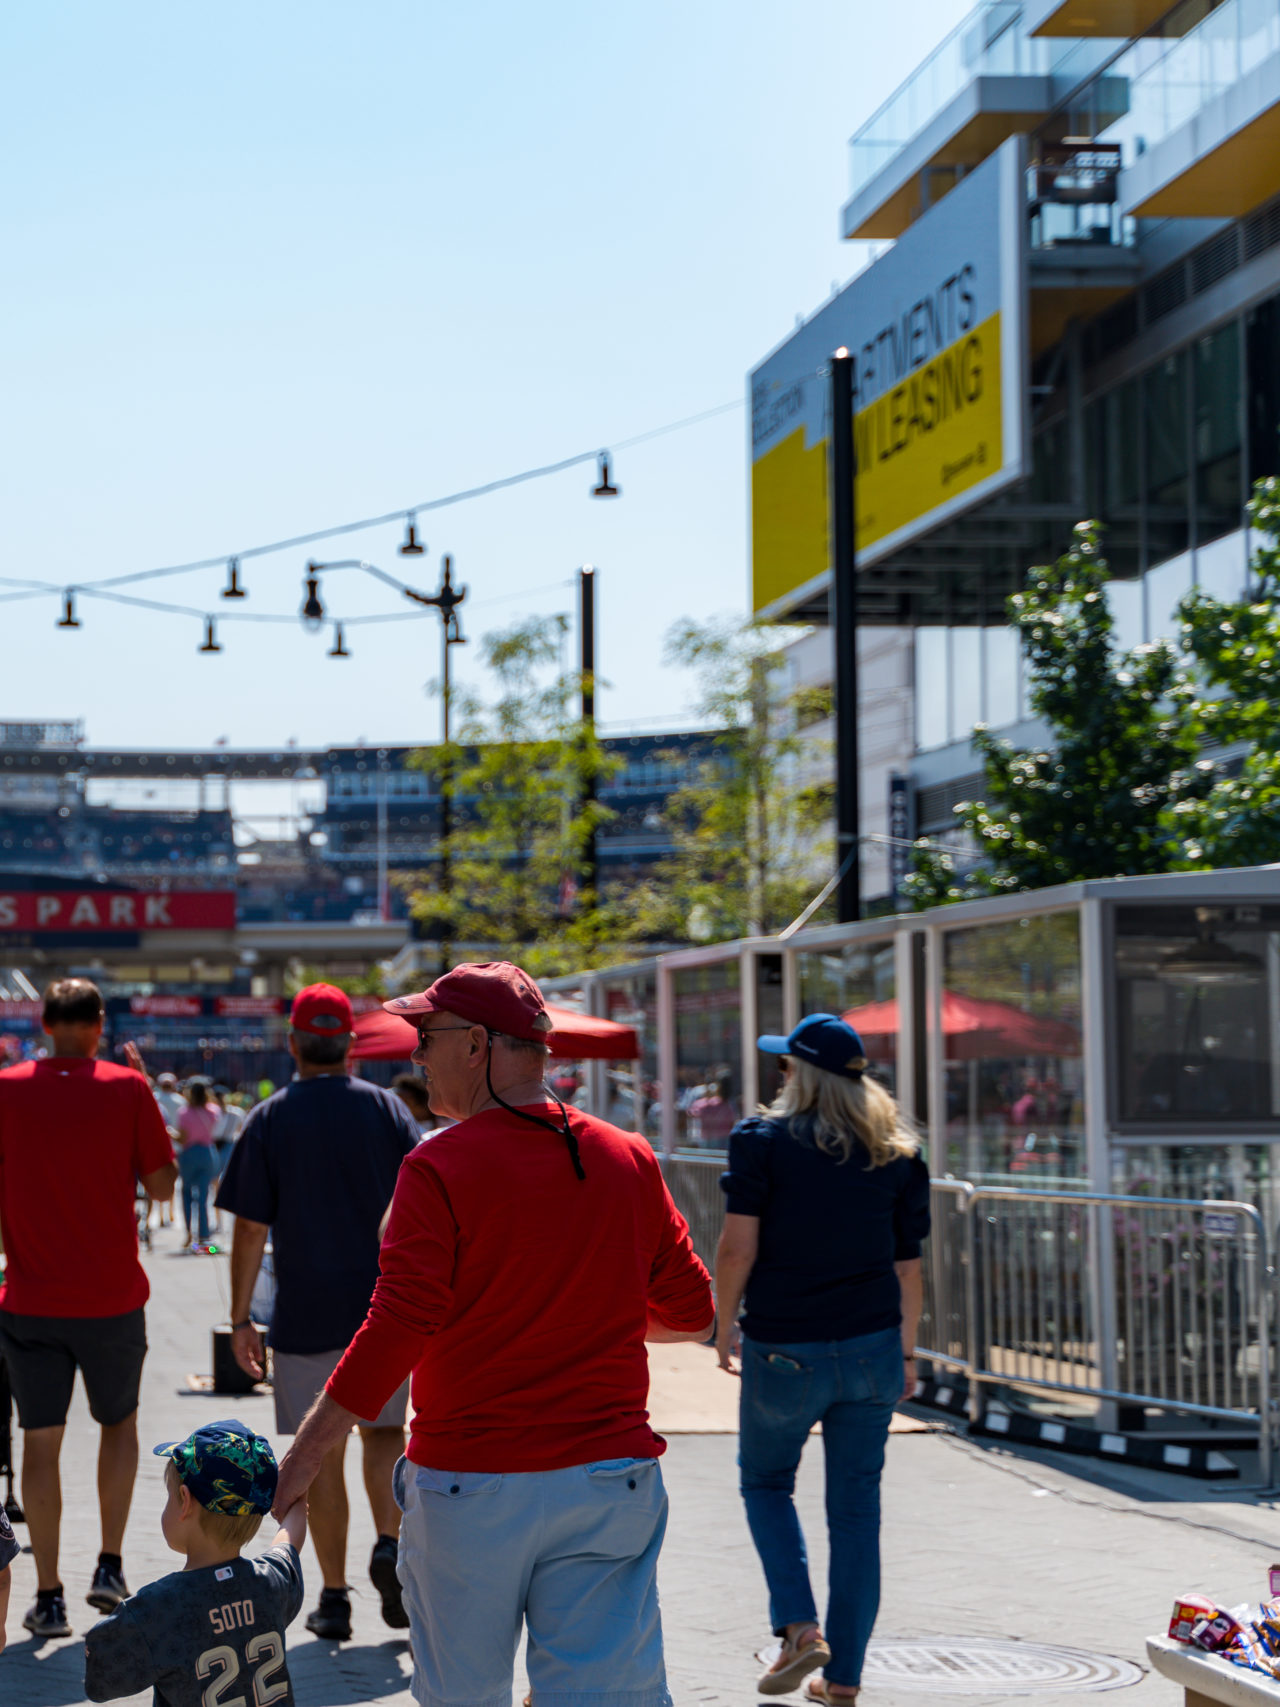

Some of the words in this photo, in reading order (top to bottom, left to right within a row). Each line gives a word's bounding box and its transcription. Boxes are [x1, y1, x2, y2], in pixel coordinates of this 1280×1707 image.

[876, 335, 984, 462] LEASING
[36, 896, 173, 926] PARK
[208, 1599, 255, 1635] SOTO
[195, 1631, 288, 1707] 22
